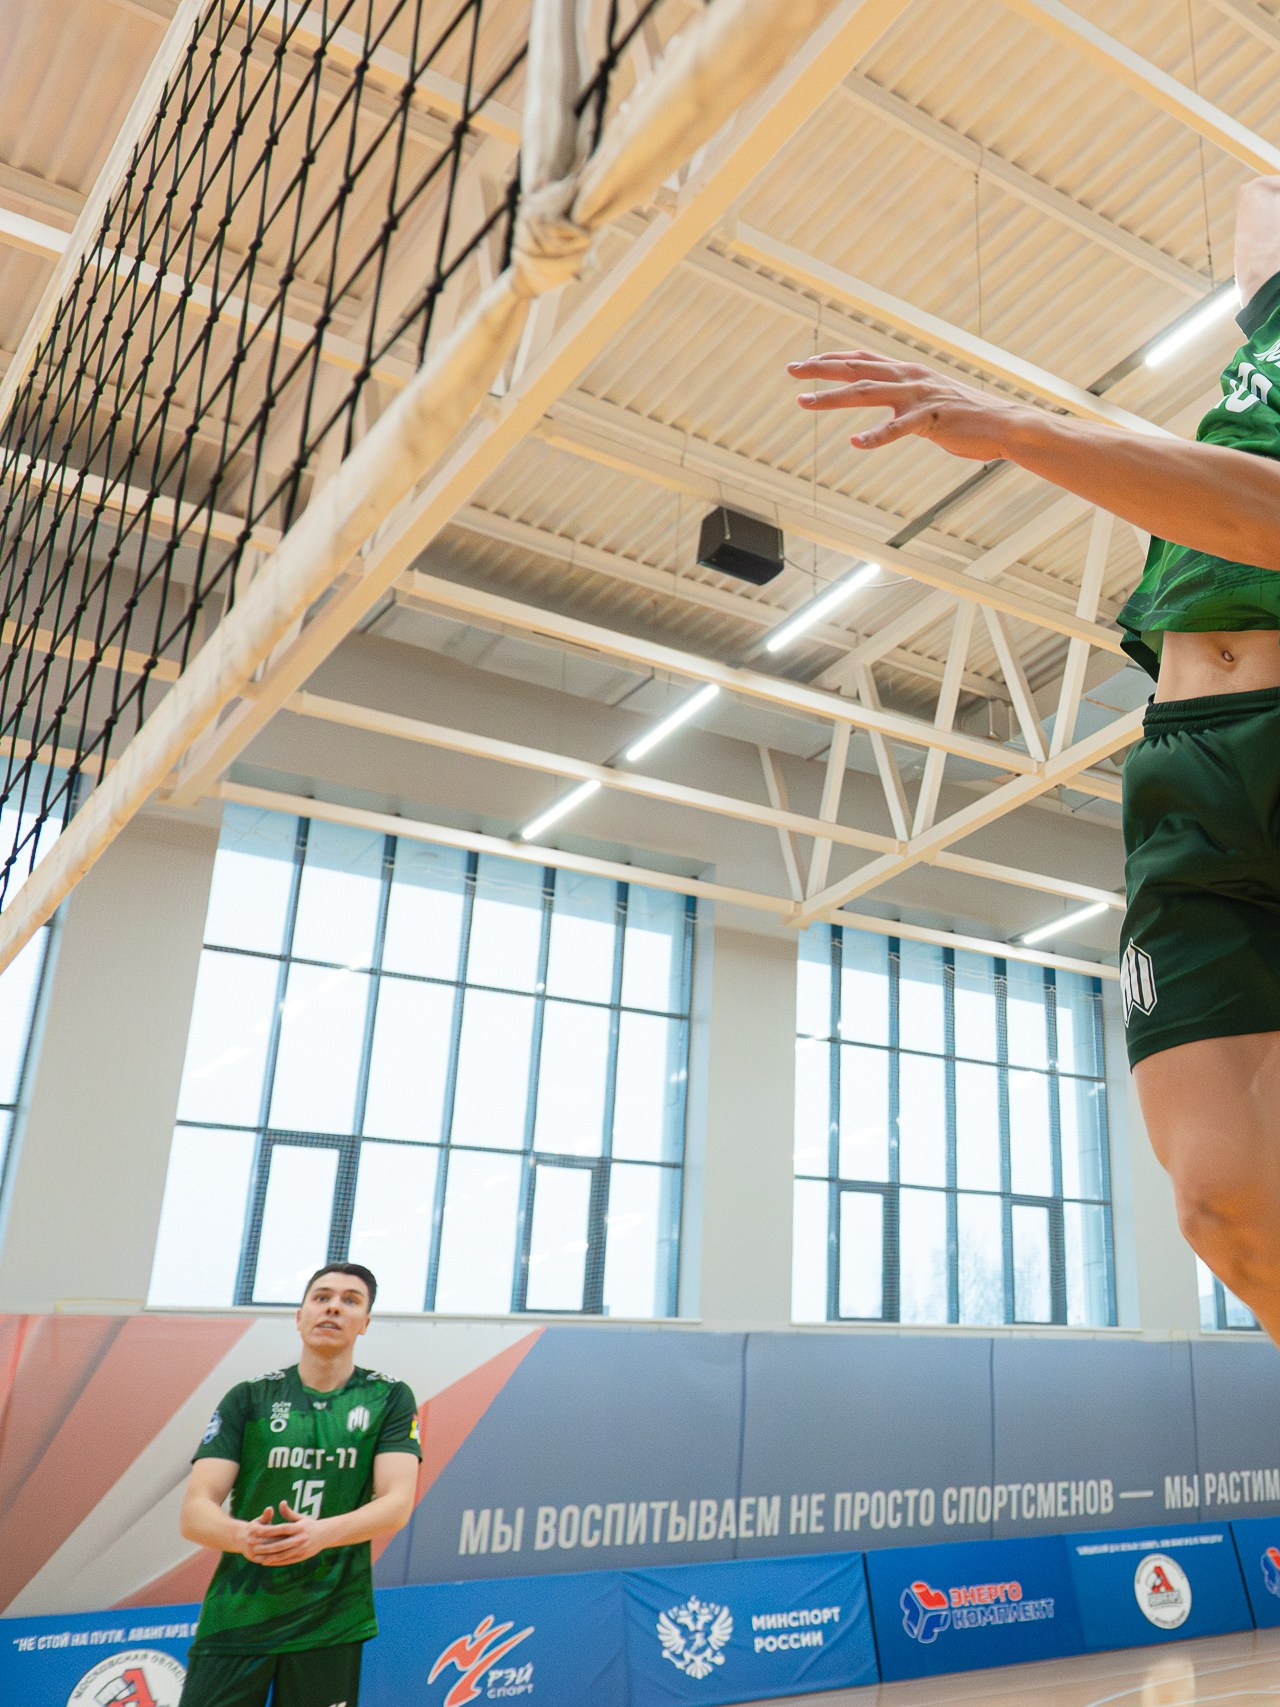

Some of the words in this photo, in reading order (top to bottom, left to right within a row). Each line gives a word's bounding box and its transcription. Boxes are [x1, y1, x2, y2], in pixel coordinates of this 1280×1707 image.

[267, 1446, 357, 1470] МОСТ-11
[292, 1479, 326, 1521] 15
[459, 1508, 525, 1556] МЫ
[534, 1495, 780, 1552] ВОСПИТЫВАЕМ
[789, 1493, 825, 1535] НЕ
[834, 1488, 935, 1532] ПРОСТО
[942, 1478, 1114, 1527] СПОРТСМЕНОВ
[1164, 1475, 1199, 1510] МЫ
[1204, 1467, 1280, 1506] РАСТИМ
[950, 1580, 1023, 1607] ЭНЕРГО
[752, 1606, 841, 1632] МИНСПОРТ
[71, 1632, 89, 1647] НА
[754, 1630, 824, 1654] РОССИИ
